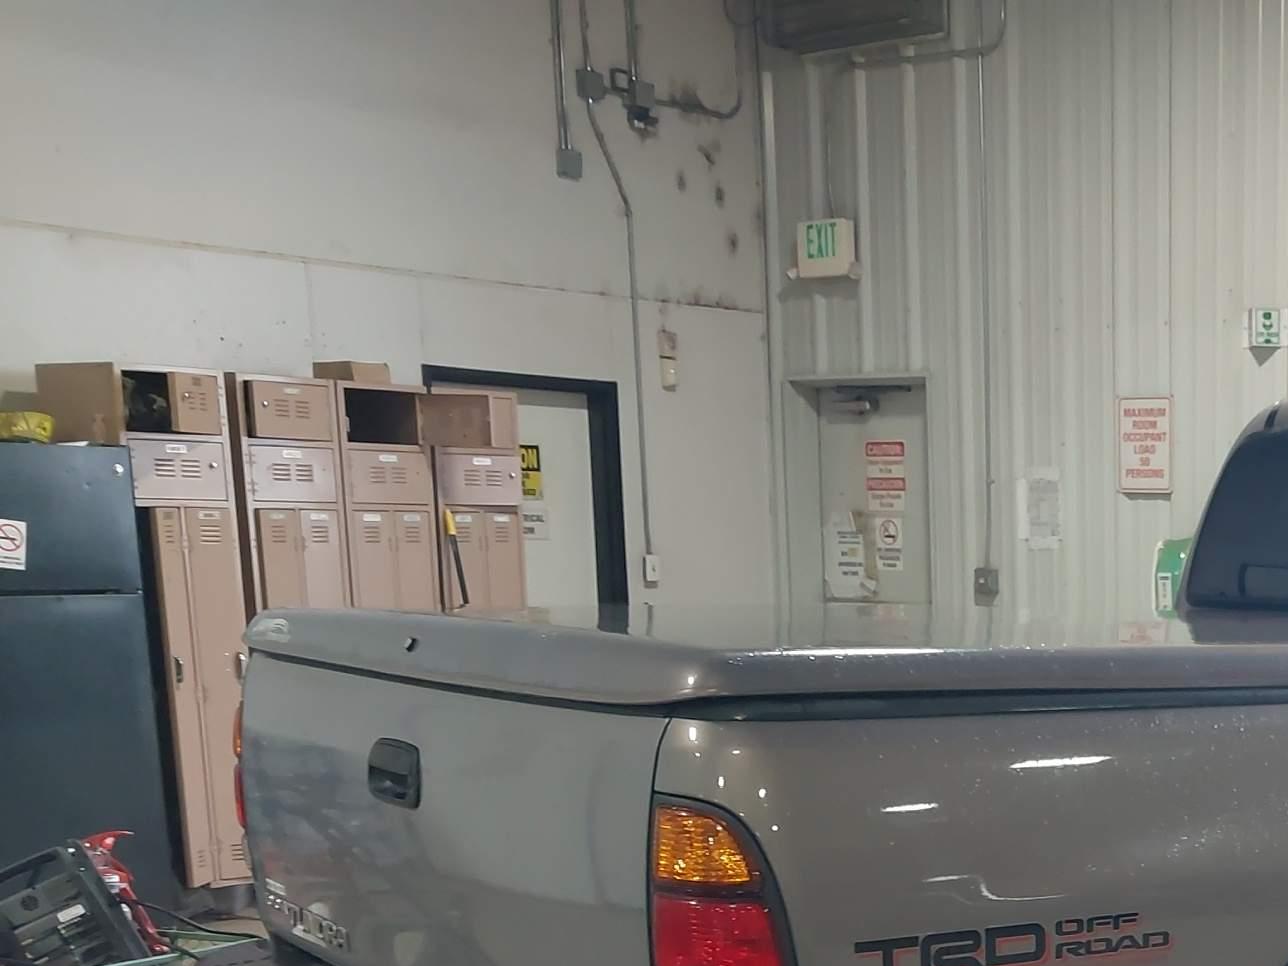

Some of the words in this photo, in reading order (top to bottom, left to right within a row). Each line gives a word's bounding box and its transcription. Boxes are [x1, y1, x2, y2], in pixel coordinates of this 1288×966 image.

[806, 222, 837, 259] EXIT
[1123, 407, 1167, 417] MAXIMUM
[1132, 419, 1158, 430] ROOM
[1122, 432, 1167, 442] OCCUPANT
[1133, 444, 1156, 455] LOAD
[1125, 468, 1164, 479] PERSONS
[1055, 912, 1139, 936] OFF
[1055, 930, 1170, 960] ROAD
